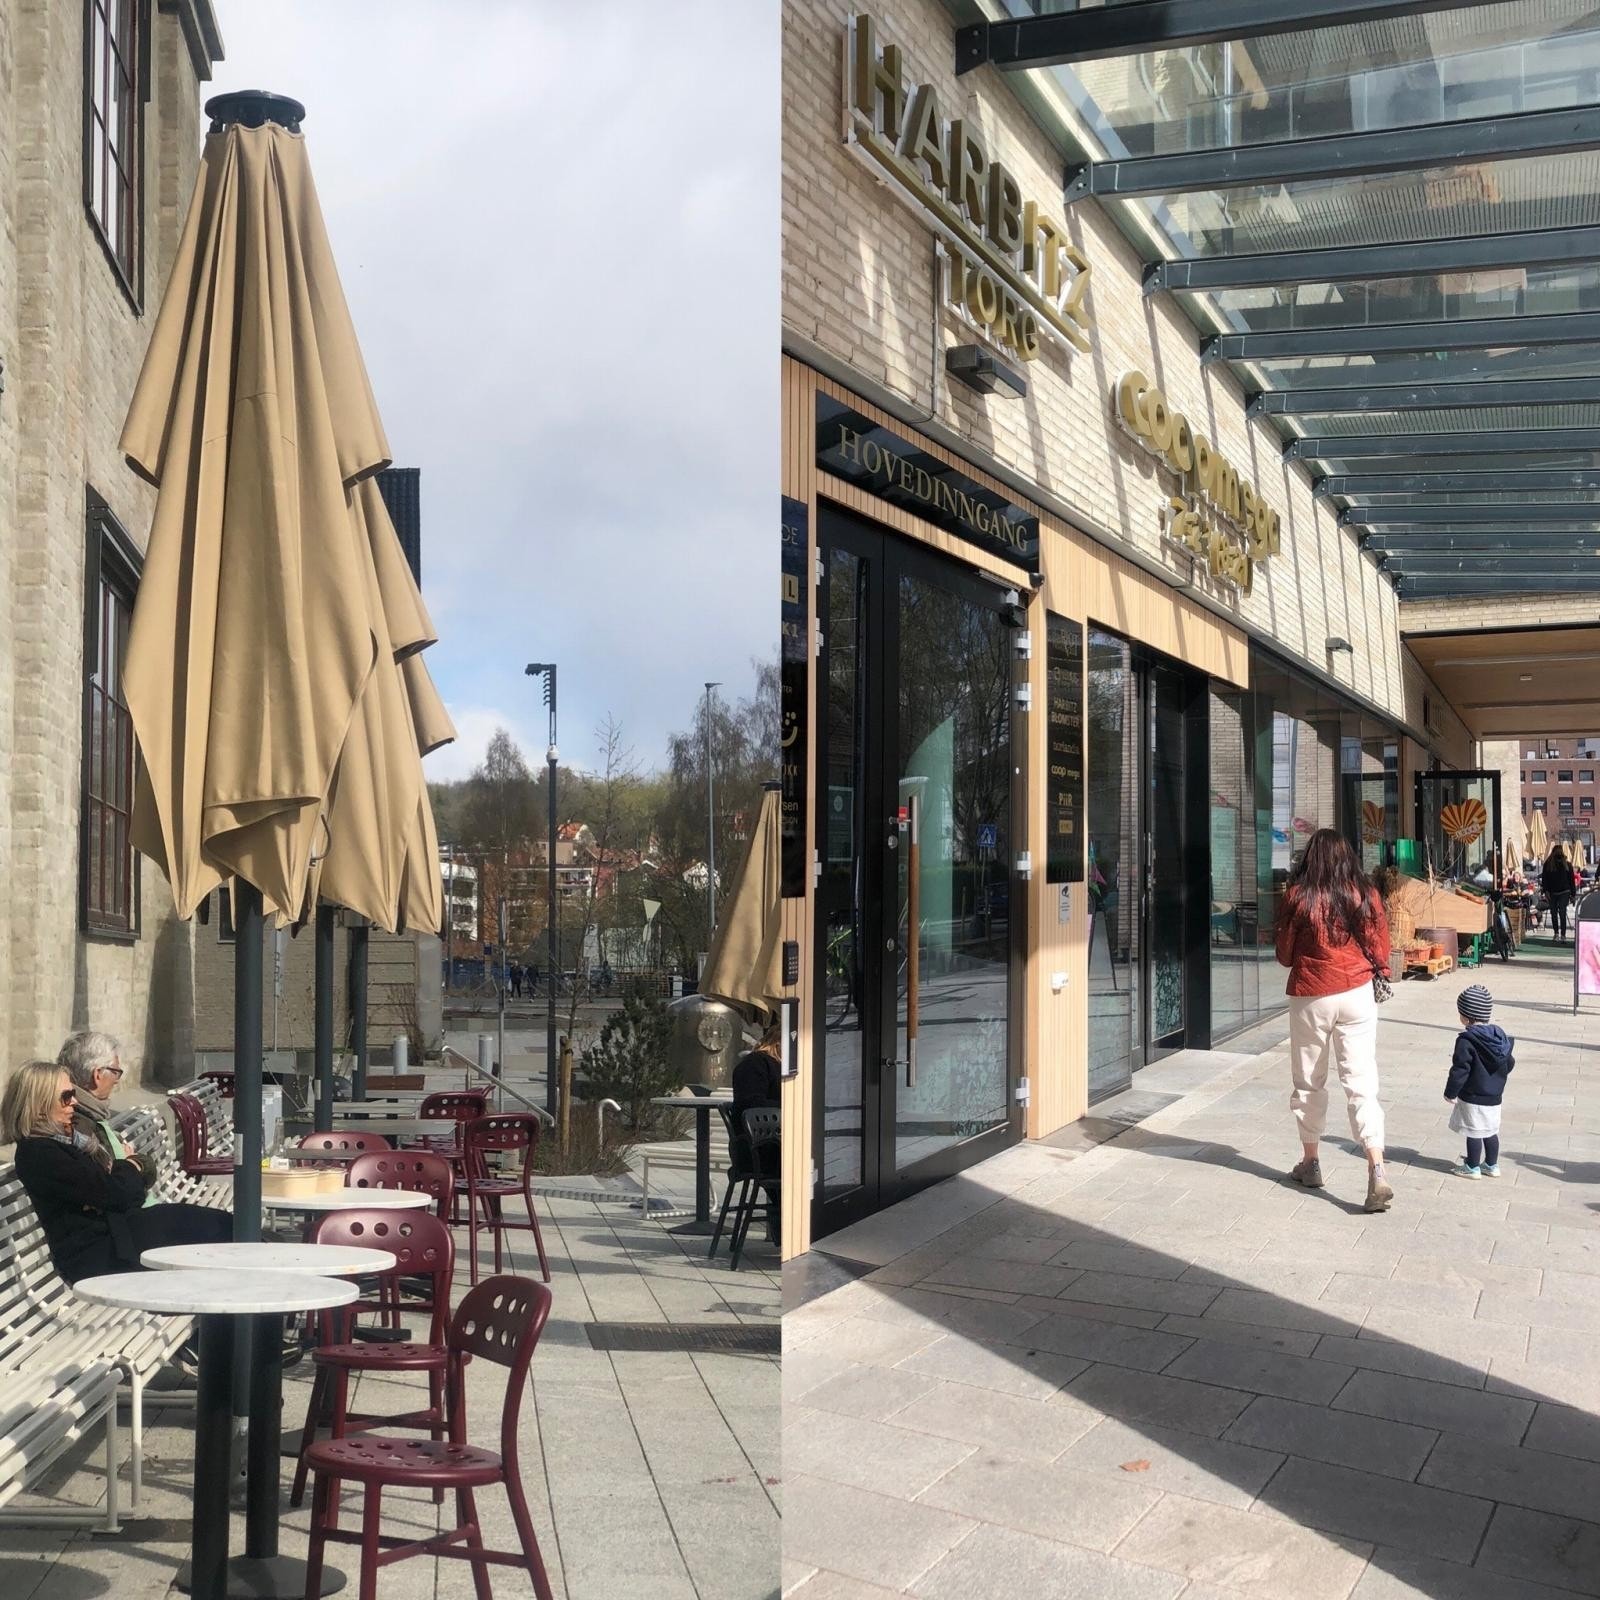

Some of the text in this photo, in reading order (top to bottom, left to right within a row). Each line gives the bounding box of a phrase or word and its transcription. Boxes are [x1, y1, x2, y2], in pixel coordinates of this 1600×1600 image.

[850, 12, 1092, 329] HARBITZ
[941, 240, 1040, 361] TORG
[838, 423, 1028, 552] HOVEDINNGANG
[1117, 369, 1217, 497] coop
[1051, 764, 1066, 778] coop
